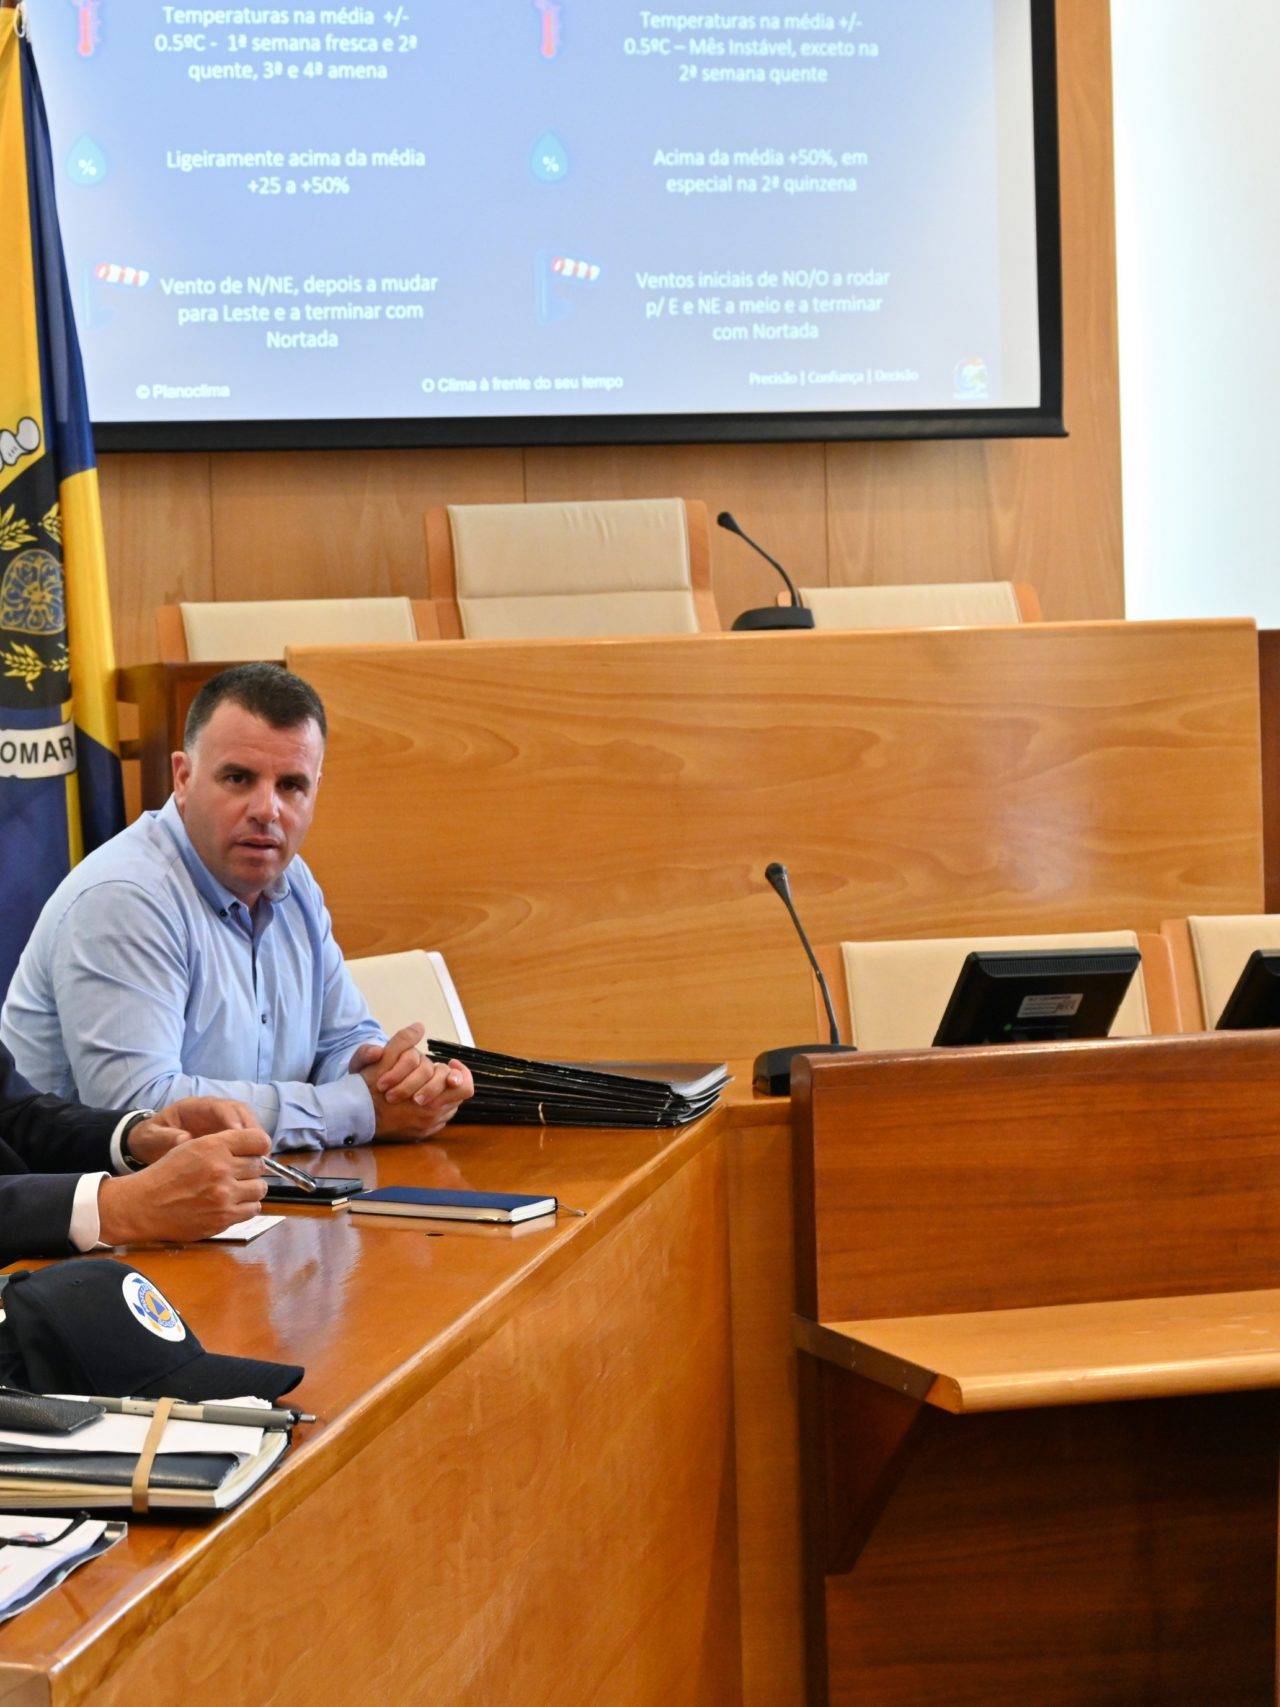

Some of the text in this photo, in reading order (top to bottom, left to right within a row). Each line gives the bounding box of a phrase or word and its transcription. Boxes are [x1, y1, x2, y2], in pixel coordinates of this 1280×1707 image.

[163, 6, 409, 27] Temperaturas na média +/-
[640, 11, 862, 32] Temperaturas na média +/-
[252, 38, 321, 51] semana
[325, 33, 378, 52] fresca
[382, 38, 394, 52] e
[689, 37, 725, 55] Mês
[729, 39, 796, 57] Instável,
[801, 41, 854, 56] exceto
[859, 43, 878, 57] na
[188, 63, 258, 82] quente,
[287, 65, 298, 78] e
[328, 65, 387, 79] amena
[702, 68, 765, 82] semana
[770, 67, 827, 85] quente
[167, 149, 425, 172] Ligeiramente acima da média
[654, 148, 867, 167] Acima da média +50%, em
[248, 177, 350, 194] +25 a +50%
[666, 175, 732, 195] especial
[737, 178, 757, 192] na
[783, 175, 857, 195] quinzena
[160, 274, 438, 295] Vento de N/NE, depois a mudar
[636, 268, 890, 288] Ventos iniciais de NO/O a rodar
[178, 303, 423, 325] para Leste e a terminar com
[646, 294, 882, 318] p/ E e NE a meio e a terminar
[267, 330, 338, 348] Nortada
[712, 322, 818, 340] com Nortada
[422, 378, 435, 392] O
[438, 378, 477, 392] Clima
[492, 377, 531, 390] frente
[534, 376, 551, 390] do
[555, 378, 578, 389] seu
[582, 375, 623, 391] tempo
